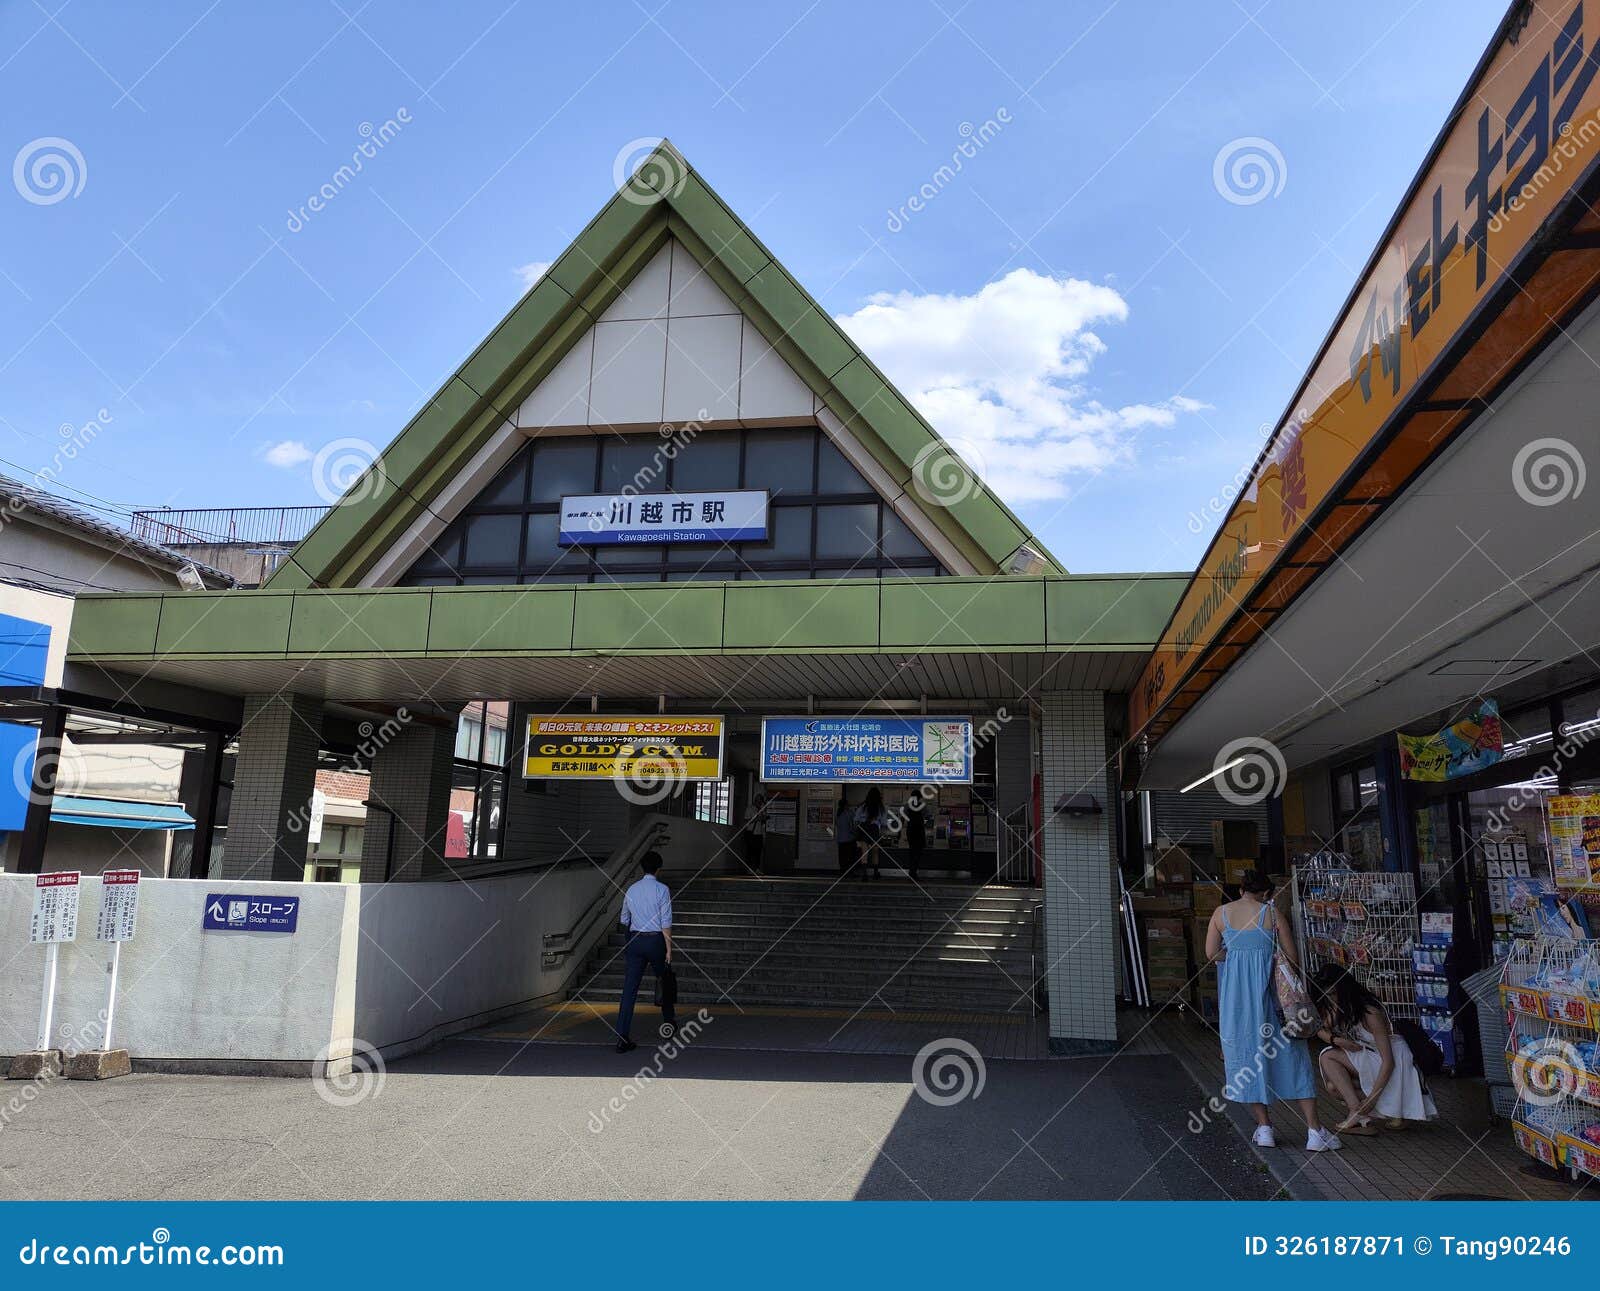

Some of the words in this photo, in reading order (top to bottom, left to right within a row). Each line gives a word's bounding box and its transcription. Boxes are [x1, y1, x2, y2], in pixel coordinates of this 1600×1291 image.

[610, 500, 725, 524] 川越市駅
[617, 531, 671, 543] Kawagoeshi
[673, 530, 706, 541] Station
[539, 743, 635, 756] GOLD'S
[769, 734, 919, 753] 川越整形外科内科医院
[249, 901, 296, 915] スロープ
[249, 915, 268, 924] Slope
